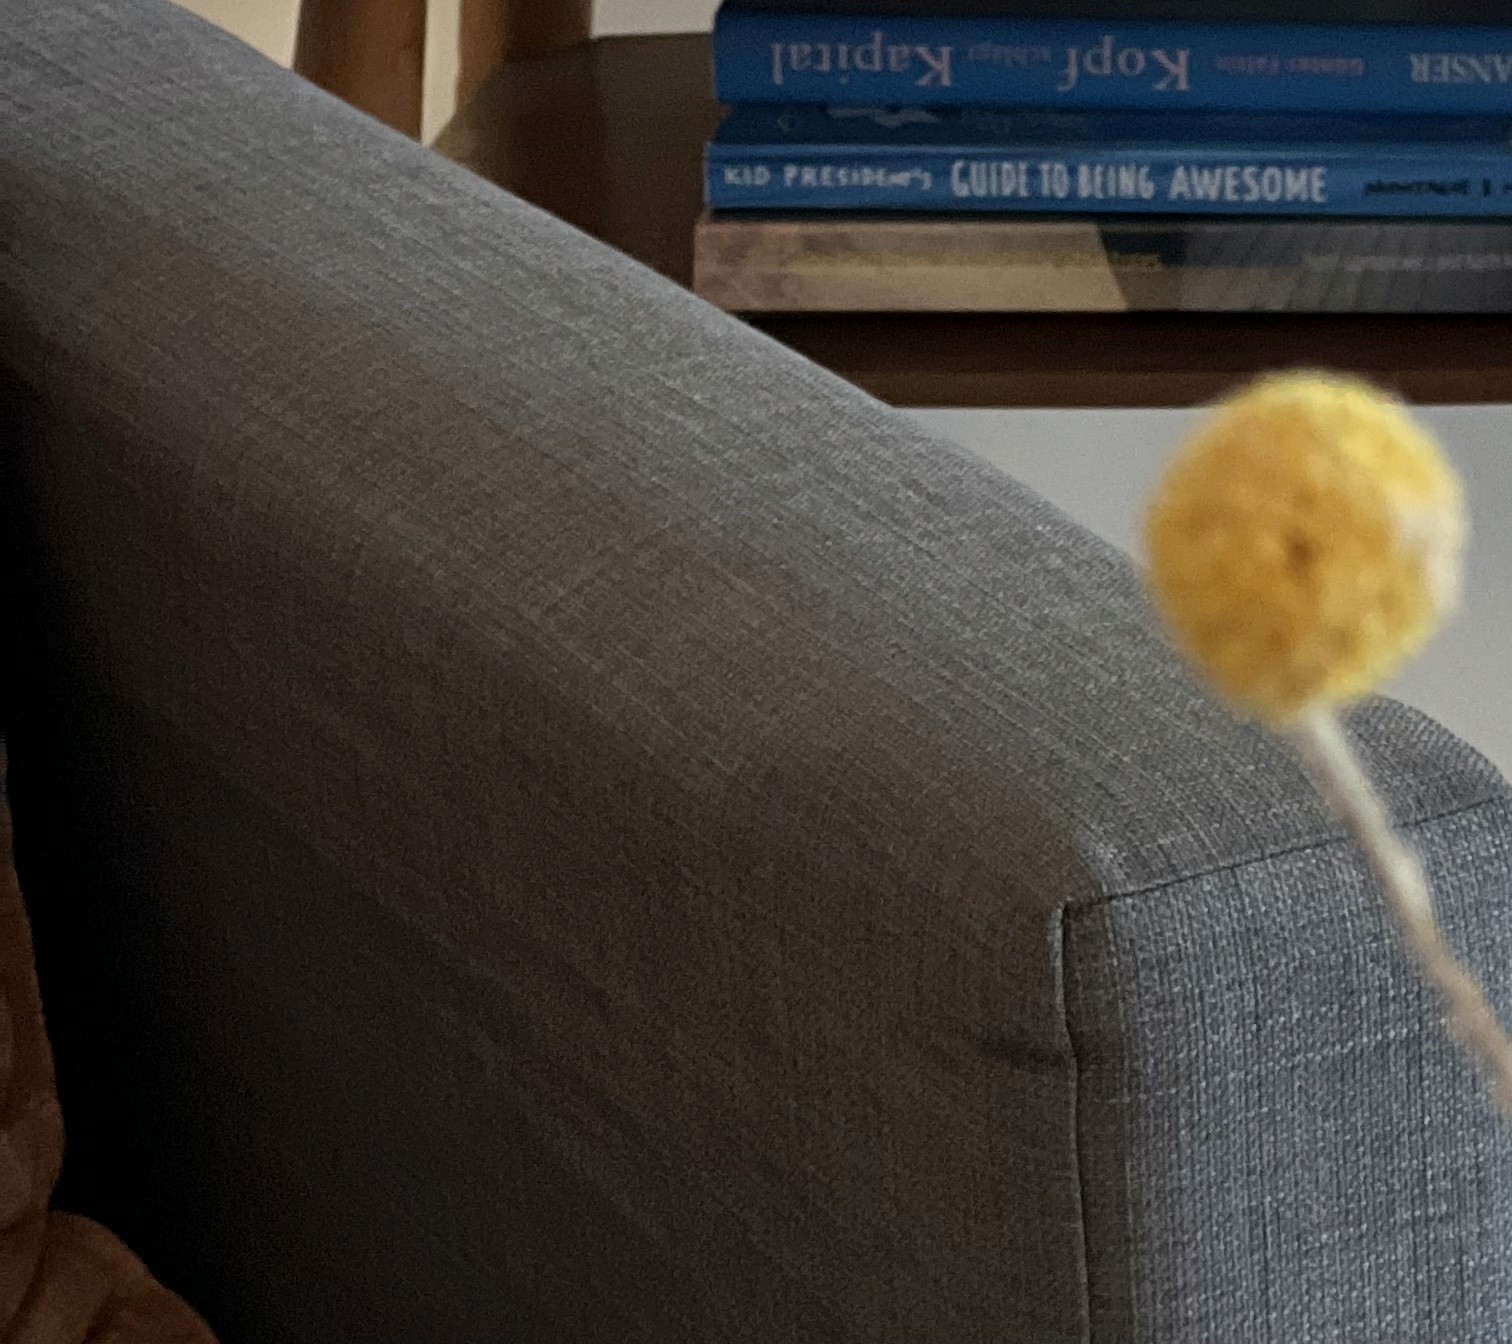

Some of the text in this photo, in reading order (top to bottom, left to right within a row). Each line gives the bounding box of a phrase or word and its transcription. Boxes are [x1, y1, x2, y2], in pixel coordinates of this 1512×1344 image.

[770, 30, 953, 87] Kapital
[1056, 35, 1191, 93] Kopf
[723, 164, 771, 187] KID
[951, 159, 1029, 198] GUIDE
[1039, 162, 1069, 199] TO
[1076, 163, 1156, 200] BEING
[1167, 164, 1329, 203] AWESOME
